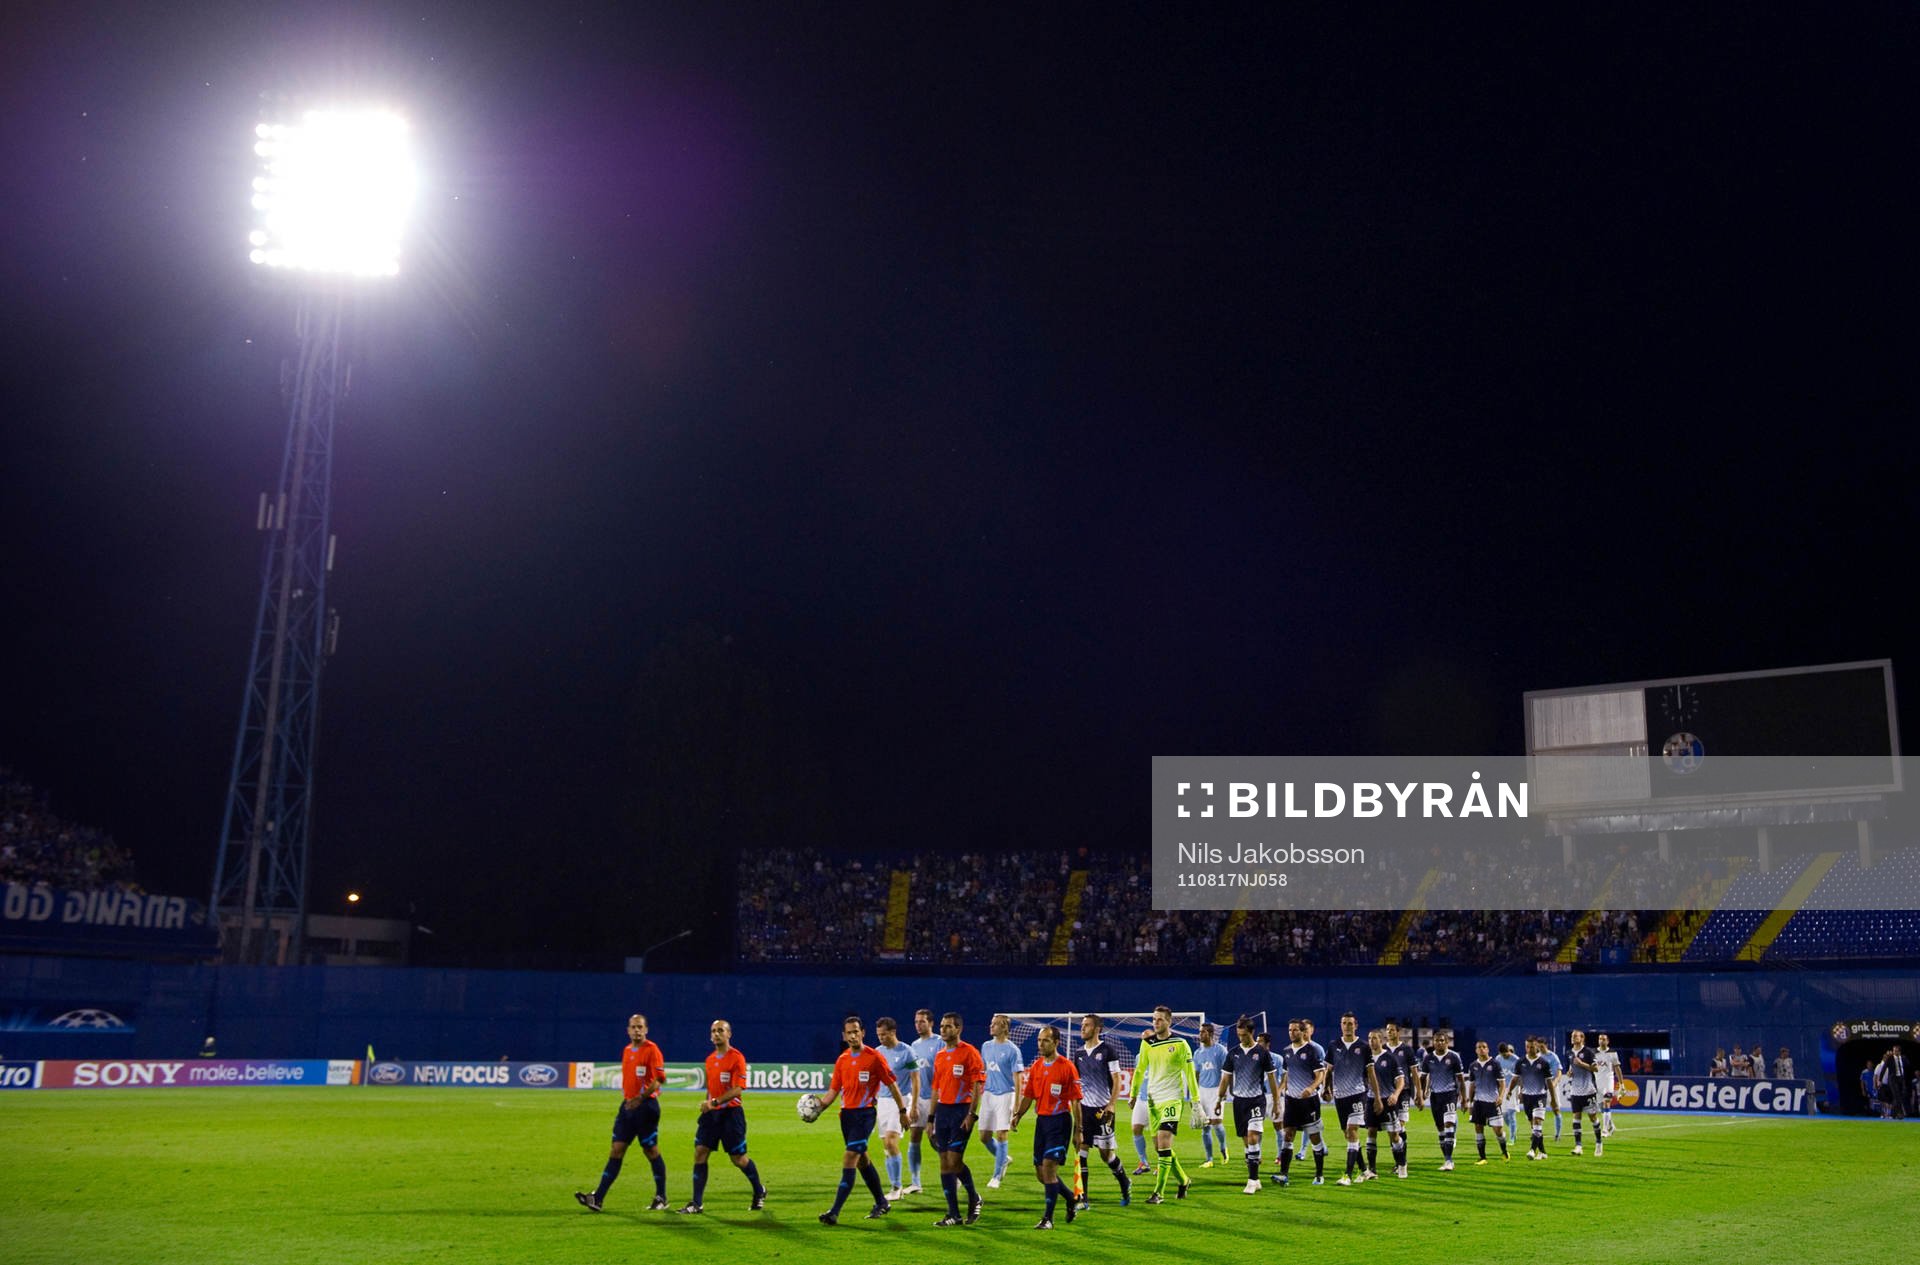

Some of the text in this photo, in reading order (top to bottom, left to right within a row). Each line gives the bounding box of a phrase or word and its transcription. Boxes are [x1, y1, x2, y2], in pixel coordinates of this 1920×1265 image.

[1851, 1021, 1910, 1034] gnk dinamo
[73, 1062, 305, 1086] SONY make.believe
[413, 1065, 510, 1083] NEW FOCUS
[746, 1064, 825, 1089] ineken
[1644, 1079, 1806, 1112] MasterCar
[1164, 1106, 1176, 1117] 30
[1250, 1106, 1262, 1118] 13
[1100, 1123, 1113, 1136] 16
